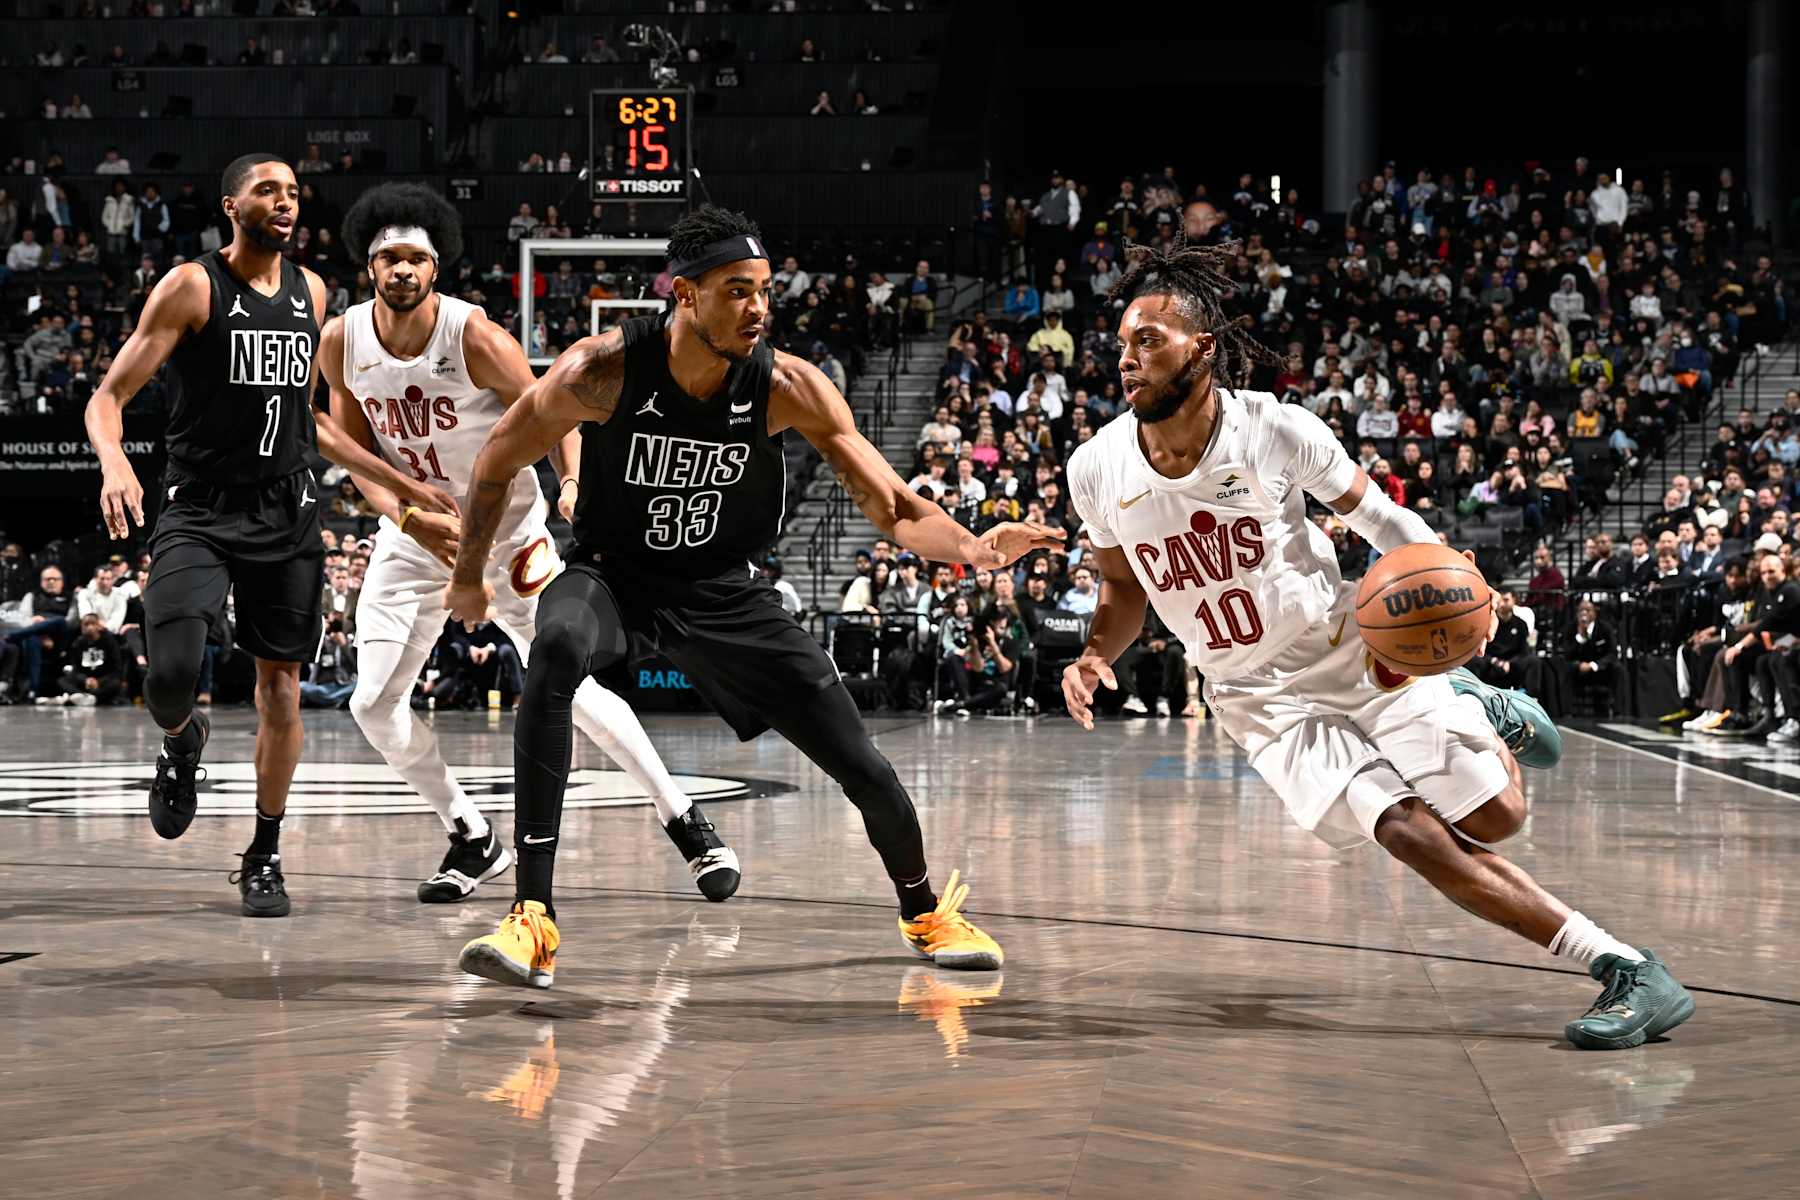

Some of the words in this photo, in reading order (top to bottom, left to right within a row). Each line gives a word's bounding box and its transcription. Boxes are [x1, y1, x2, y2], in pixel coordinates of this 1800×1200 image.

[619, 97, 676, 124] 6:27
[306, 130, 340, 143] LOGE
[344, 130, 371, 143] BOX
[628, 126, 668, 170] 15
[455, 187, 473, 200] 31
[620, 180, 684, 193] TISSOT
[229, 329, 312, 387] NETS
[258, 394, 281, 457] 1
[364, 396, 458, 440] CAVS
[2, 442, 54, 455] HOUSE
[58, 442, 79, 455] OF
[82, 442, 155, 455] SORY
[397, 442, 450, 482] 31
[624, 432, 750, 488] NETS
[1216, 487, 1249, 499] CLIFFS
[645, 490, 722, 550] 33
[1135, 515, 1265, 592] CAVS
[1195, 588, 1264, 650] 10
[1382, 583, 1475, 617] Wilson
